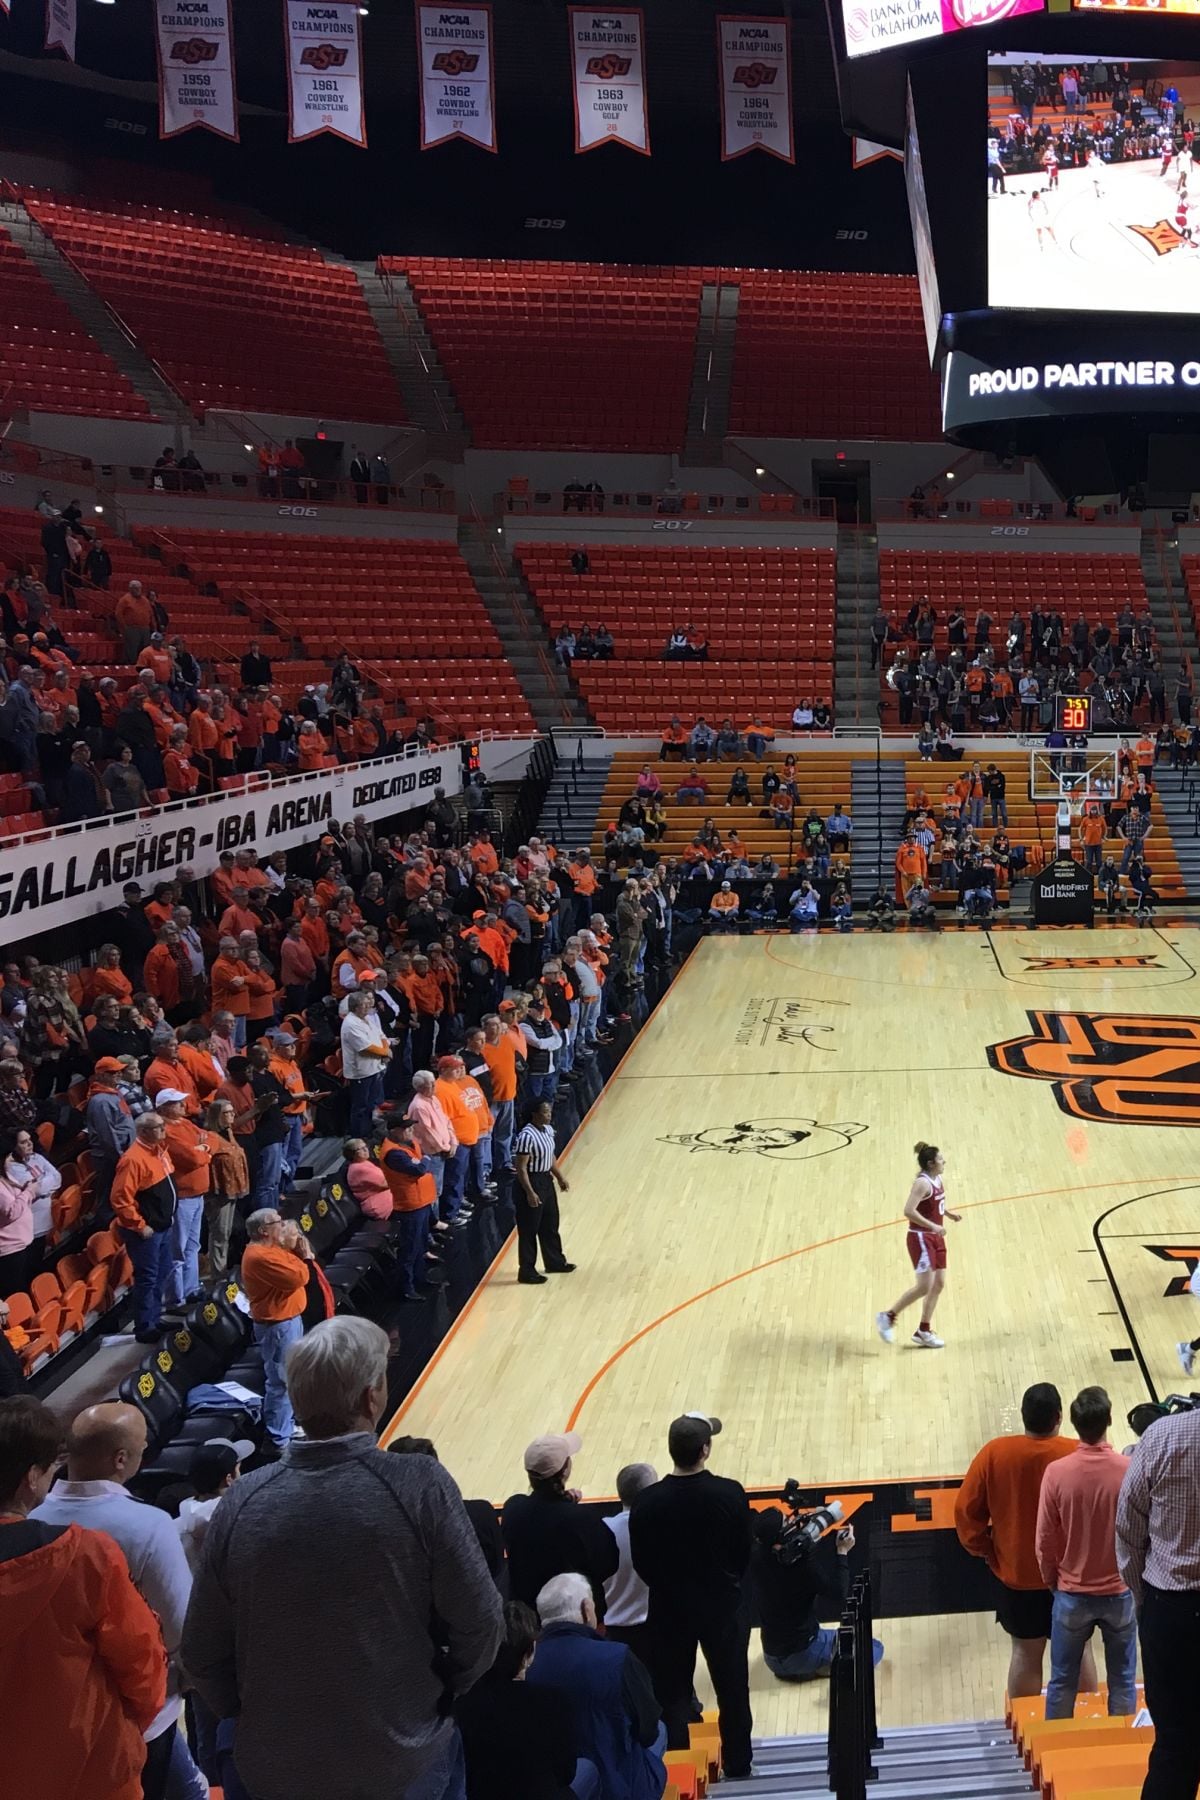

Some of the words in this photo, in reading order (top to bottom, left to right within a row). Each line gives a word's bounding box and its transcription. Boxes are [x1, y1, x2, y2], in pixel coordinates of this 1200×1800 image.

[176, 3, 208, 13] NCAA
[306, 8, 338, 19] NCAA
[870, 1, 904, 21] BANK
[162, 15, 225, 27] CHAMPIONS
[439, 14, 470, 25] NCAA
[592, 19, 622, 29] NCAA
[871, 11, 940, 38] OKLAHOMA
[292, 21, 354, 33] CHAMPIONS
[425, 27, 485, 39] CHAMPIONS
[577, 31, 637, 43] CHAMPIONS
[739, 28, 769, 38] NCAA
[725, 41, 783, 52] CHAMPIONS
[300, 43, 349, 70] OSU
[432, 50, 480, 75] OSU
[585, 54, 632, 79] OSU
[183, 74, 211, 86] 1959
[732, 62, 778, 88] OSU
[312, 80, 338, 91] 1961
[443, 85, 471, 97] 1962
[178, 88, 216, 97] COWBOY
[597, 89, 623, 100] 1963
[178, 97, 218, 106] BASEBALL
[307, 94, 344, 103] COWBOY
[439, 99, 475, 108] COWBOY
[743, 98, 769, 108] 1964
[305, 102, 349, 112] WRESTLING
[436, 108, 479, 117] WRESTLING
[593, 102, 628, 112] COWBOY
[602, 112, 620, 120] GOLF
[739, 111, 774, 120] COWBOY
[103, 118, 148, 135] 308
[737, 120, 778, 128] WRESTLING
[524, 217, 567, 230] 309
[835, 229, 869, 241] 310
[968, 367, 1039, 397] PROUD
[1044, 361, 1175, 389] PARTNER
[278, 506, 318, 517] 206
[652, 520, 693, 530] 207
[990, 526, 1030, 536] 208
[1066, 698, 1088, 709] 7:57
[1063, 709, 1085, 728] 30
[352, 772, 417, 808] DEDICATED
[419, 766, 441, 788] 1938
[265, 790, 333, 837] ARENA
[1056, 890, 1076, 898] BANK
